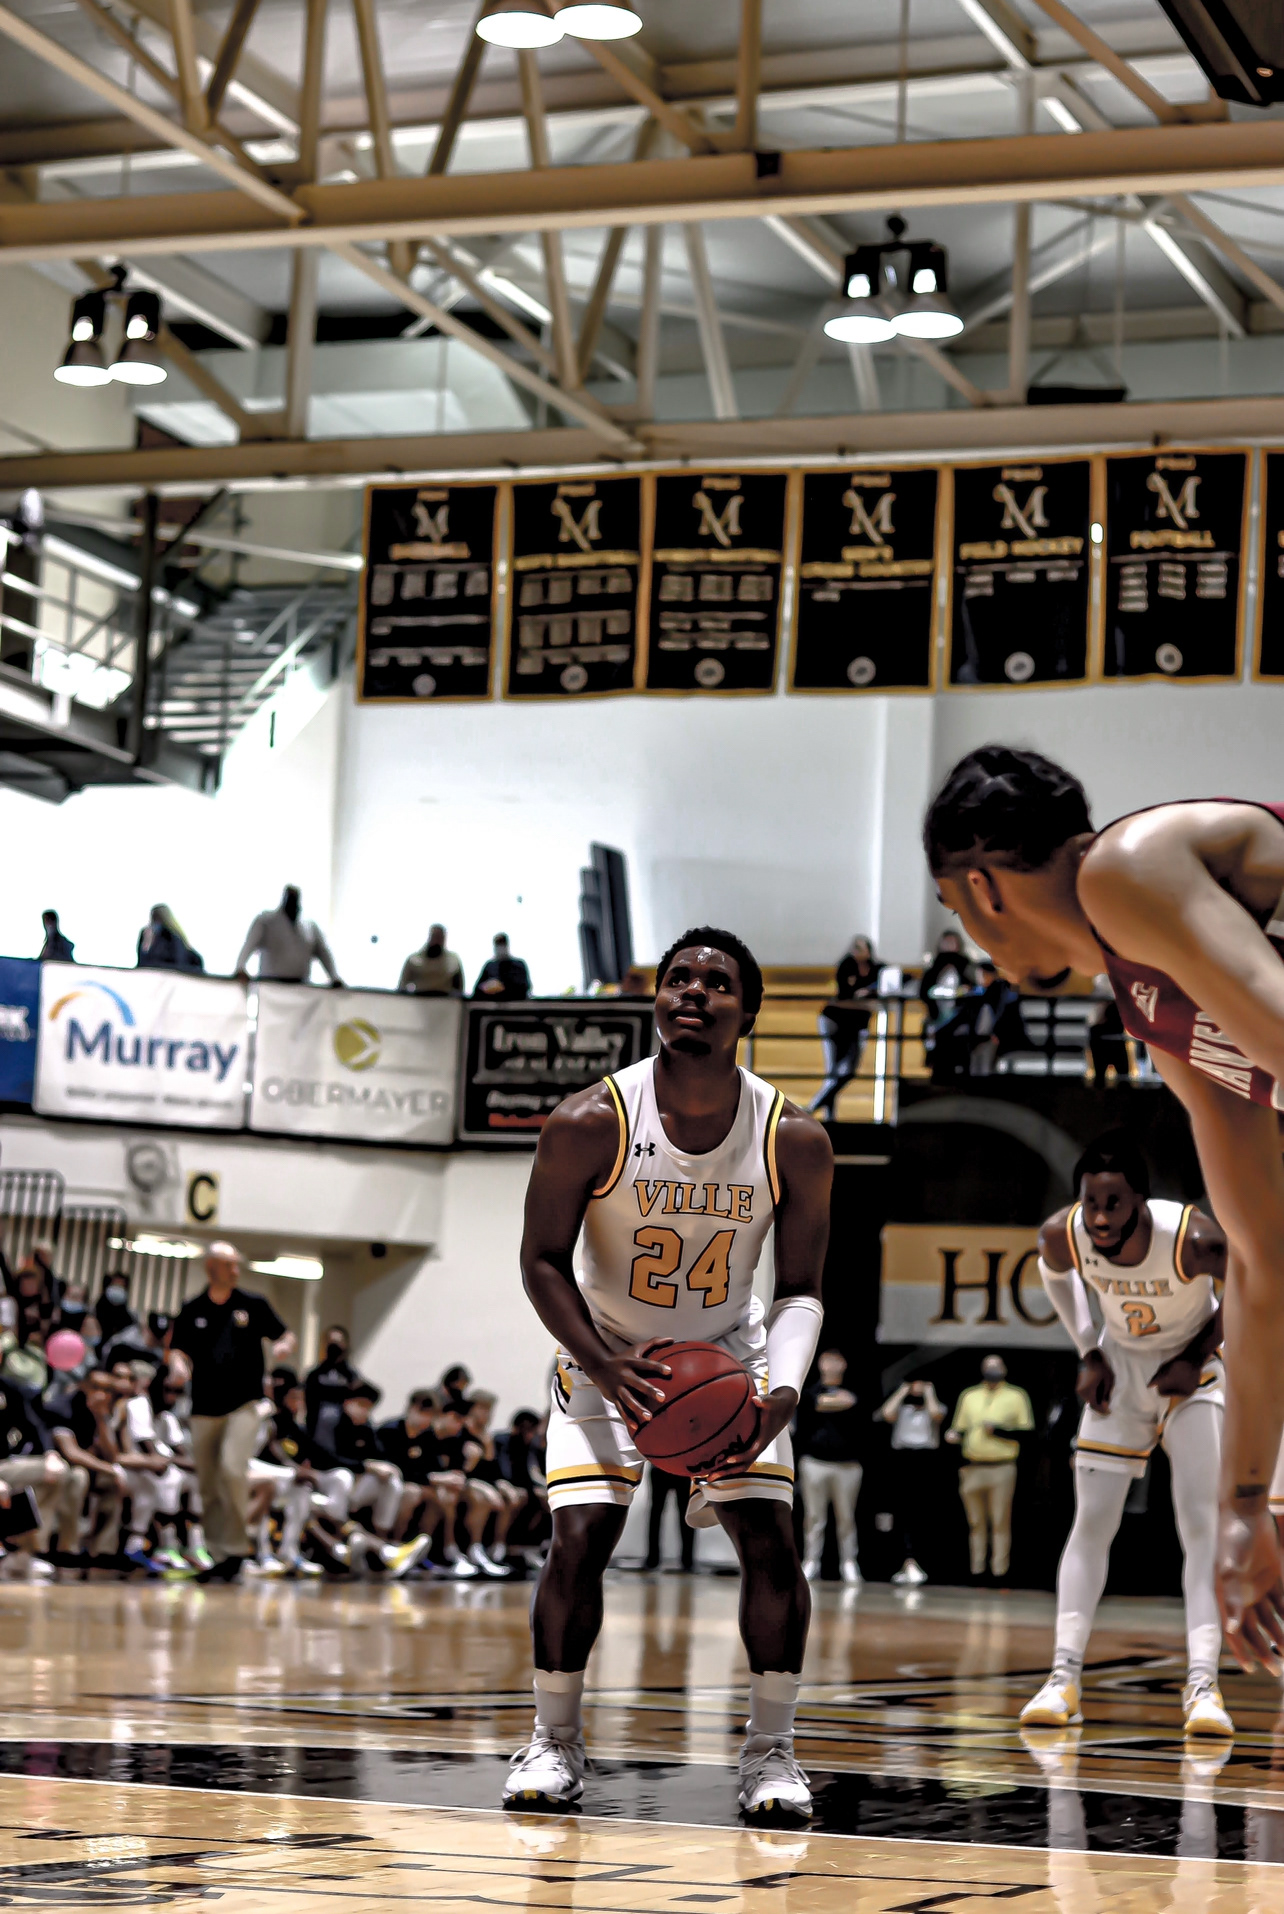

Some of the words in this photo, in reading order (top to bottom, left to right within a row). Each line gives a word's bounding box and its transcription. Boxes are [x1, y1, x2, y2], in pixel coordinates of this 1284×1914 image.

[66, 1017, 238, 1082] Murray
[261, 1076, 450, 1115] OBERMAYER
[187, 1174, 218, 1221] C
[632, 1180, 754, 1224] VILLE
[628, 1225, 737, 1309] 24
[1091, 1275, 1174, 1297] VILLE
[1121, 1300, 1161, 1337] 2
